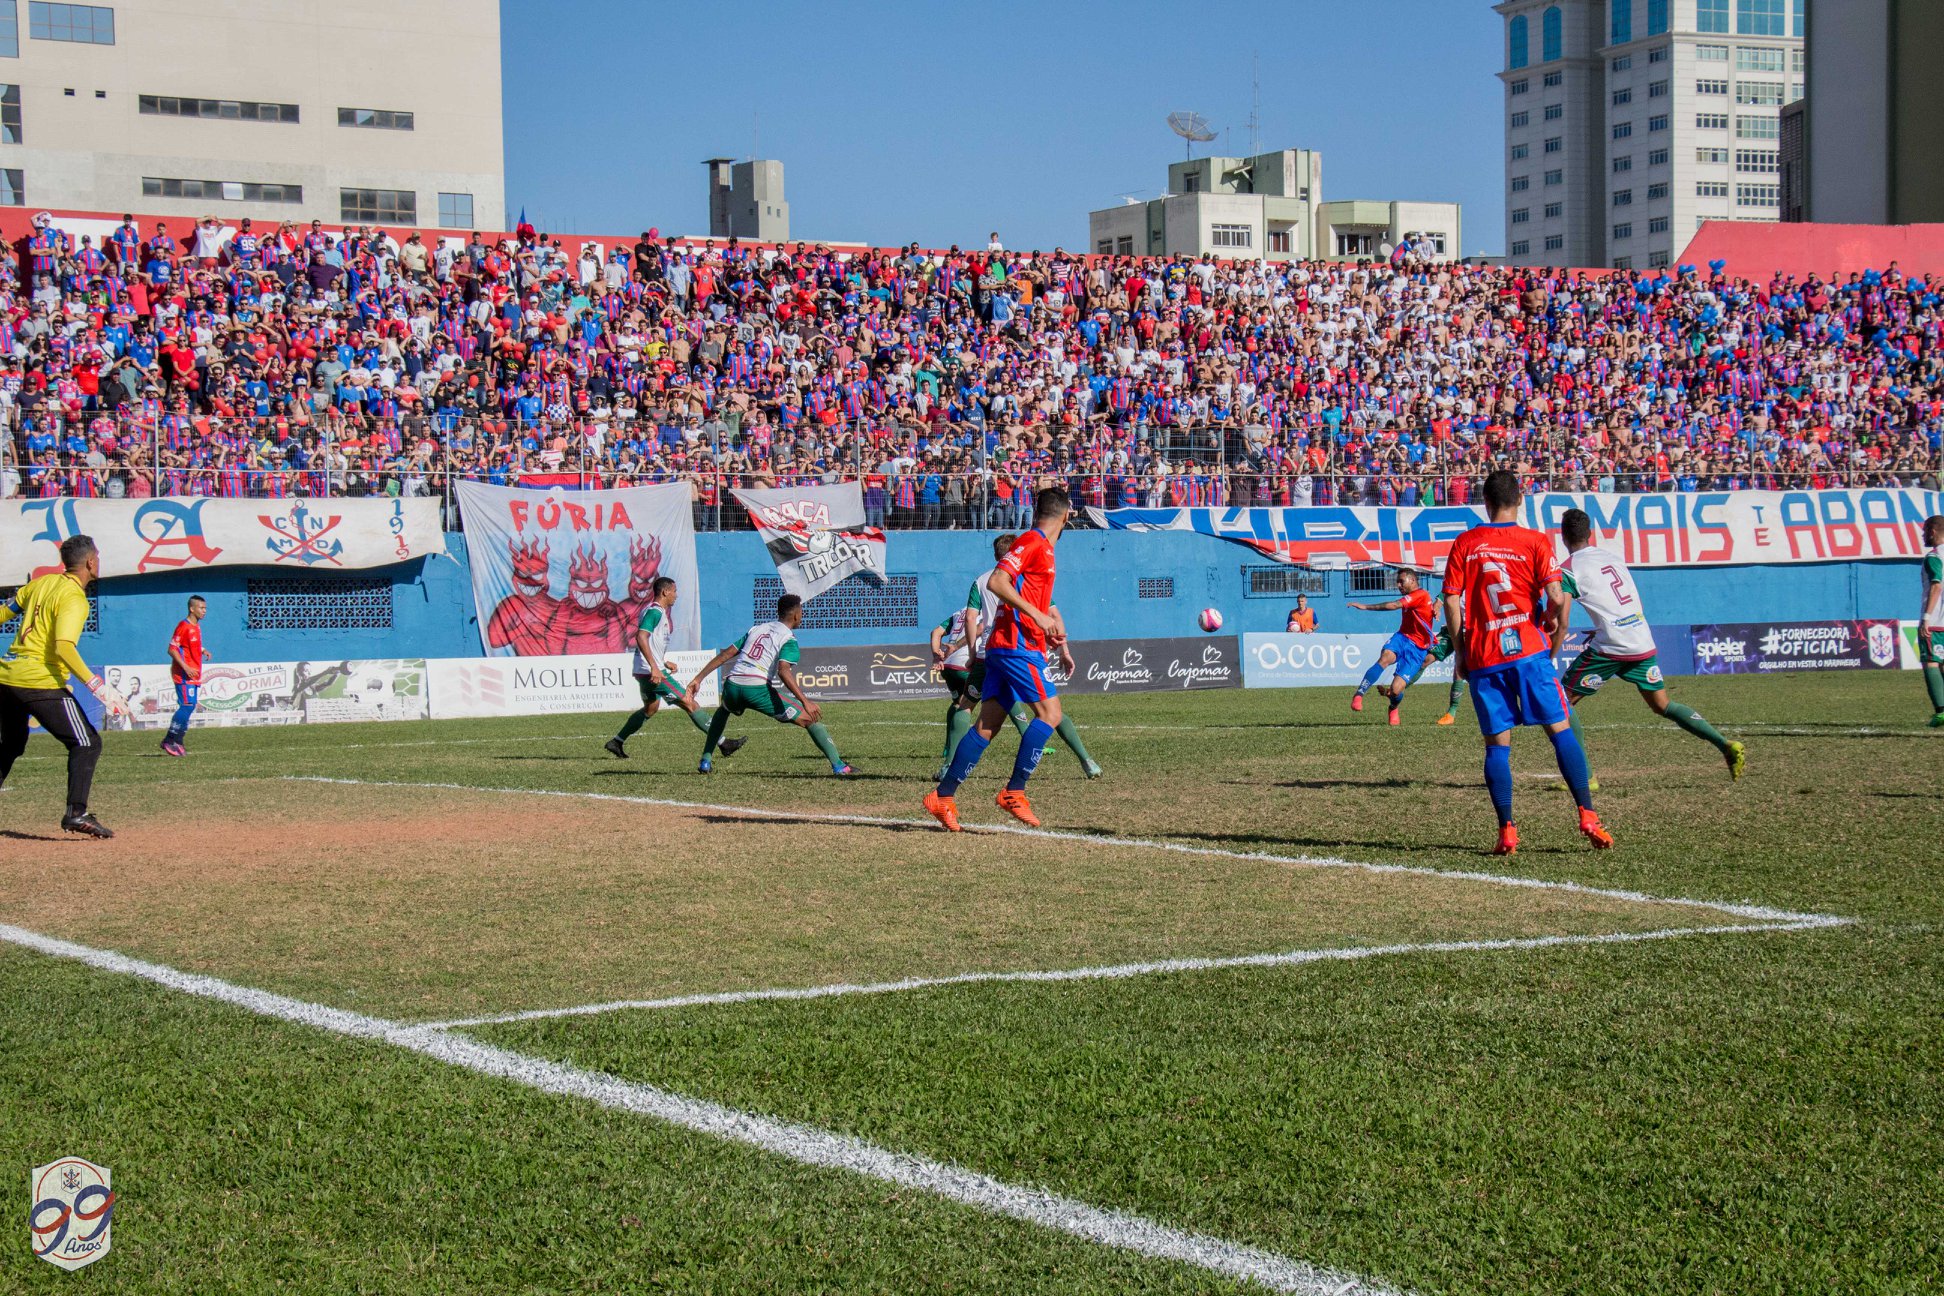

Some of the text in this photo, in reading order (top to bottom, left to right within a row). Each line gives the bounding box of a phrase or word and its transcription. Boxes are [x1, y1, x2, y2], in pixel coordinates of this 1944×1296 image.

[509, 497, 634, 533] FÚRIA
[1781, 490, 1944, 559] ABAN
[1483, 562, 1518, 614] 2
[1600, 565, 1633, 605] 2
[748, 634, 771, 660] 6
[1697, 637, 1746, 663] spieler
[1780, 640, 1851, 656] OFICIAL
[514, 664, 623, 688] MOLLÉRI
[815, 664, 848, 672] COLCHÕES
[1087, 662, 1152, 691] Cajomar
[1167, 659, 1231, 687] Cajomar
[1759, 661, 1787, 669] ORGULHO
[1797, 659, 1817, 668] VESTIR
[795, 672, 849, 687] foam
[870, 670, 927, 685] LATEX
[515, 692, 625, 702] ENGENHARIA ARQUITETURA
[549, 702, 603, 711] CONSTRUÇÃO
